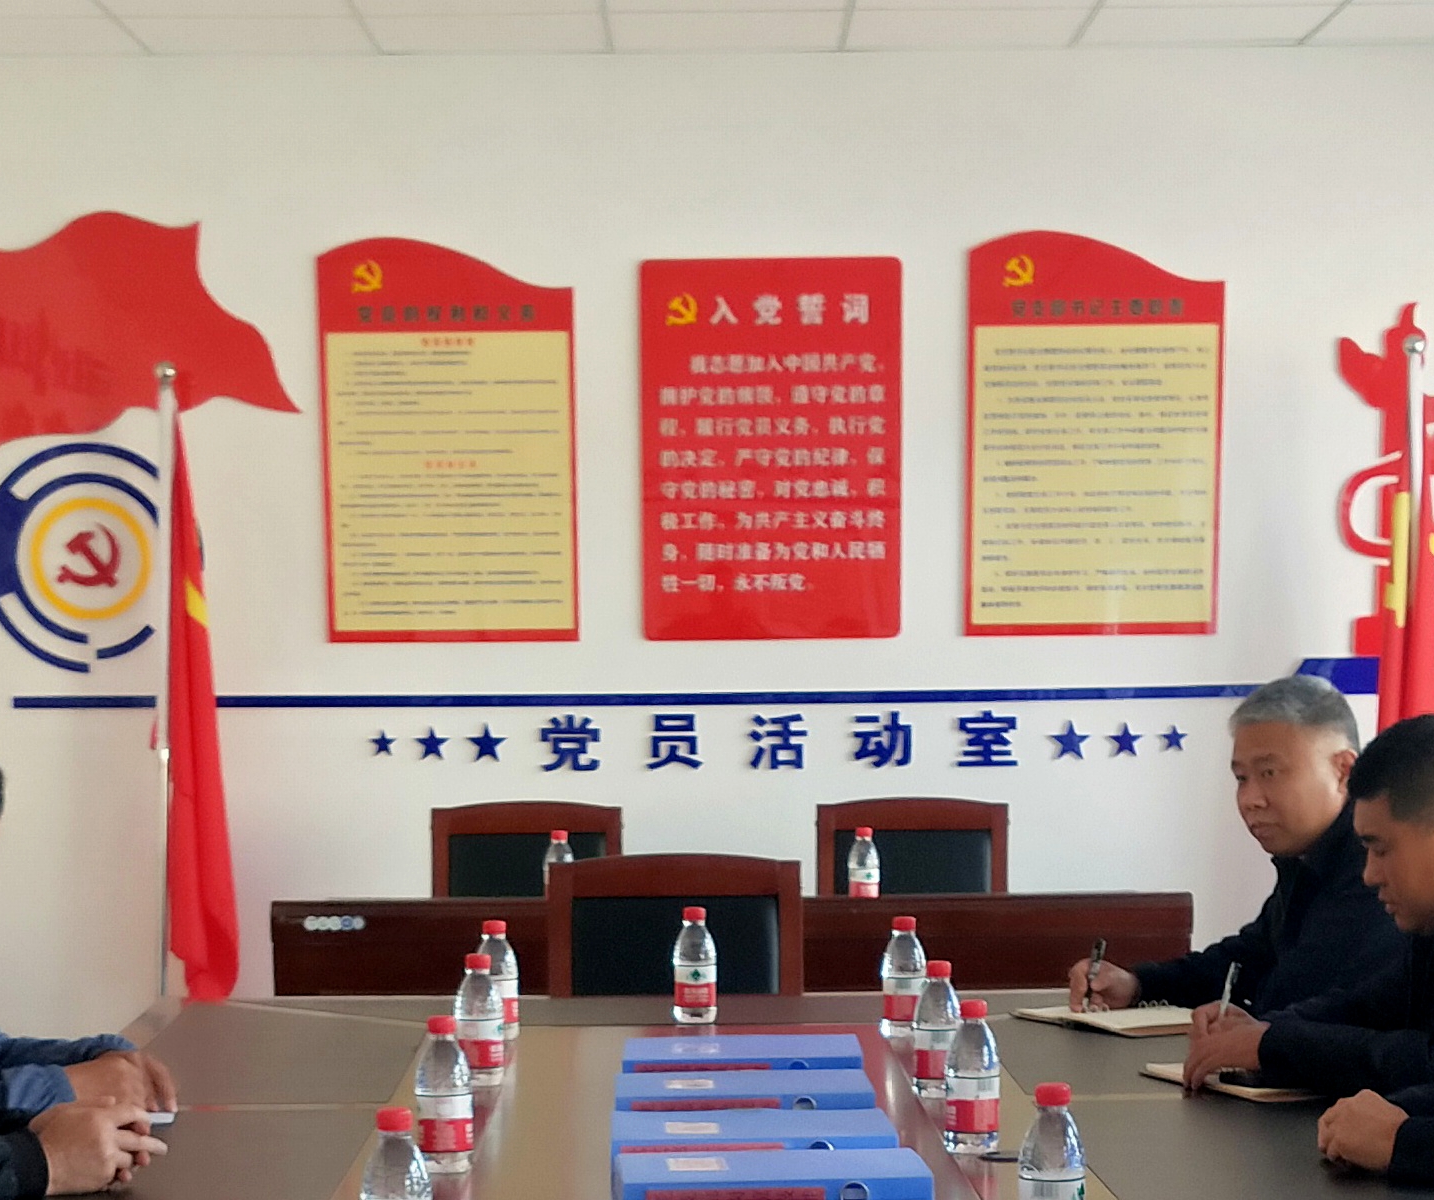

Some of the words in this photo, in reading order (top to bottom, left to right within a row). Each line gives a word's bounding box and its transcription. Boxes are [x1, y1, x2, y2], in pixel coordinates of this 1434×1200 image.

[710, 293, 870, 325] 入党誓词
[538, 710, 1020, 773] 党员活动室
